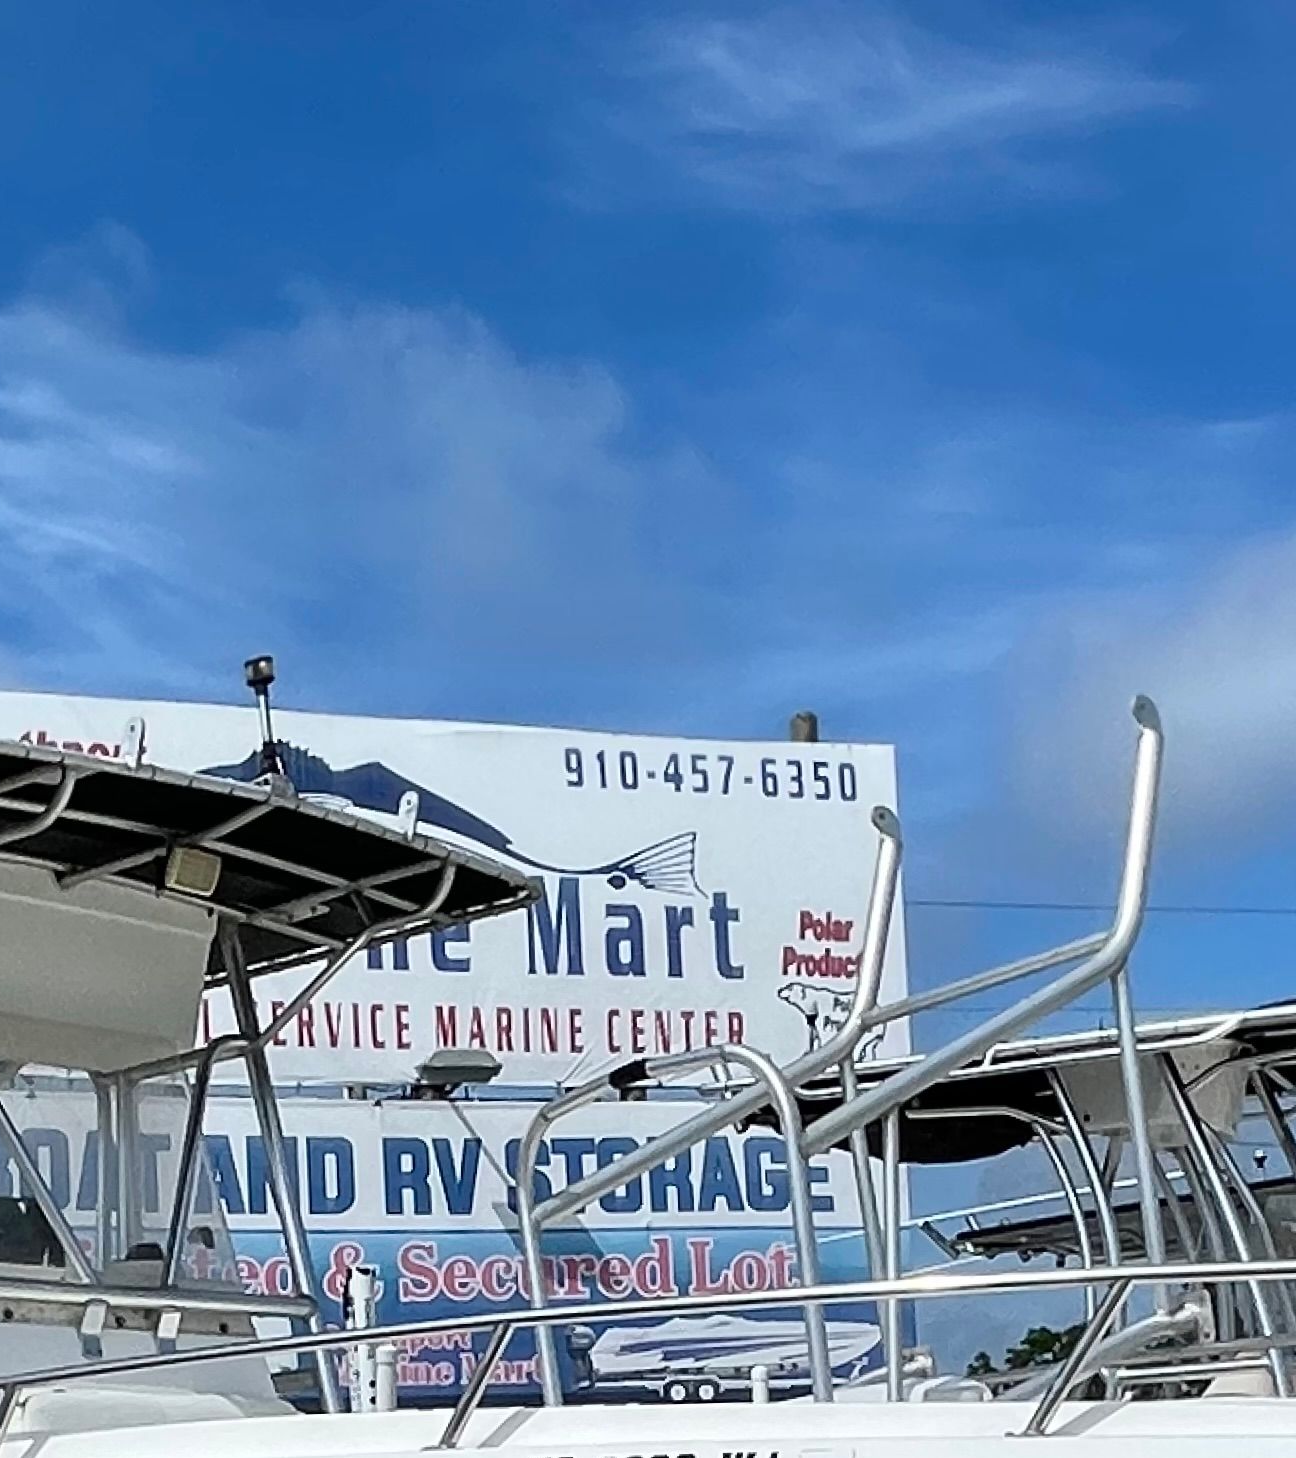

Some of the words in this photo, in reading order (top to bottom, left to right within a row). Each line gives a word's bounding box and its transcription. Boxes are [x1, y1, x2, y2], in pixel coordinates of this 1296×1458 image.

[564, 747, 857, 802] 910-457-6350
[527, 875, 745, 979] Mart
[799, 910, 853, 941] Polar
[782, 946, 864, 978] Produc
[255, 1000, 412, 1050] ERVICE
[435, 1005, 584, 1053] MARINE
[607, 1008, 744, 1053] CENTER
[194, 1134, 356, 1215] AND
[382, 1137, 482, 1216] RV
[687, 1237, 799, 1296] Lot
